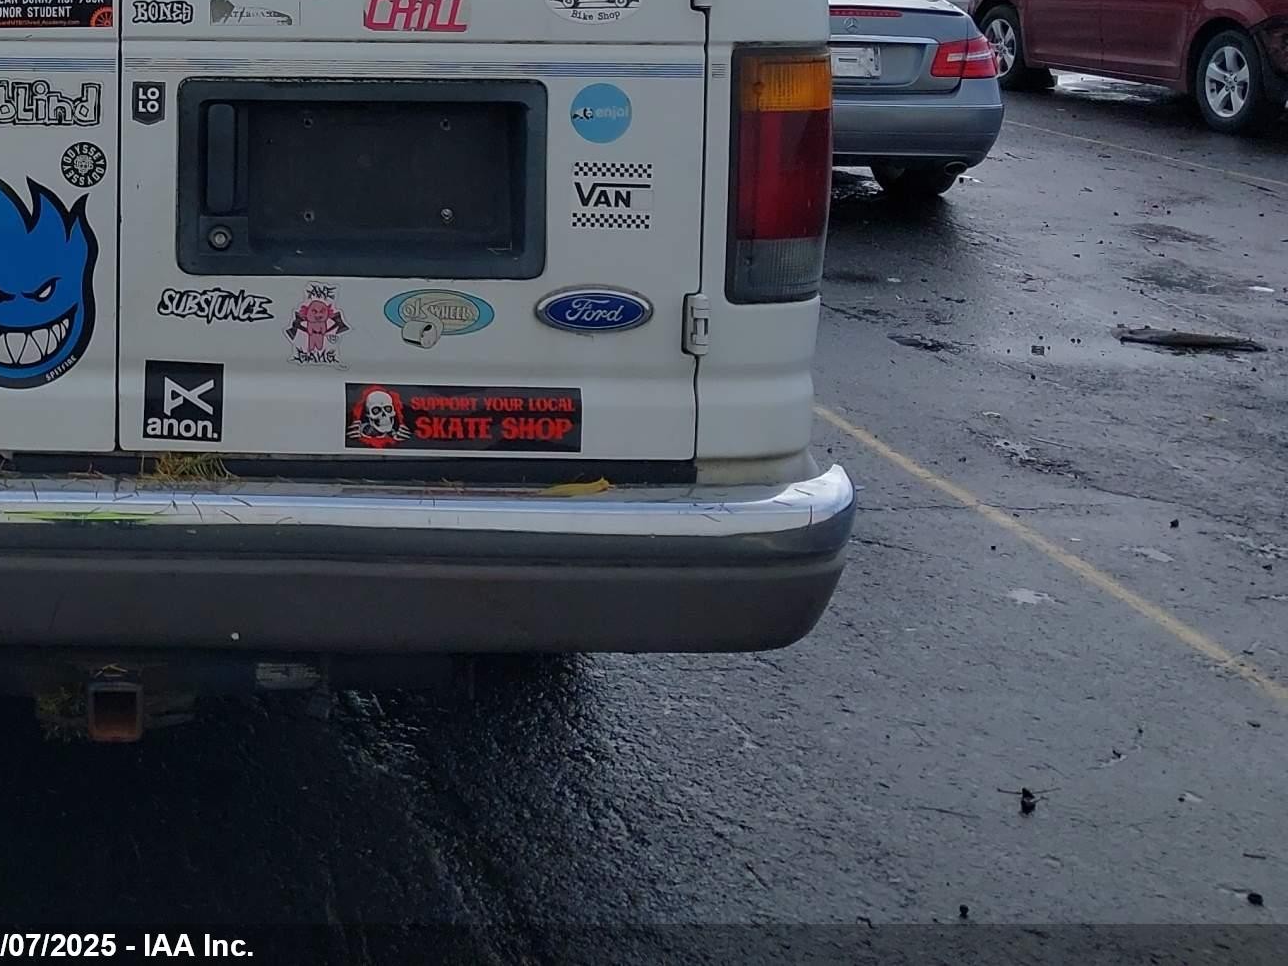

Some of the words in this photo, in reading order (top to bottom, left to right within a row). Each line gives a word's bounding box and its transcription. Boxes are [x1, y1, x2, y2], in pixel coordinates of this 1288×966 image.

[27, 6, 72, 18] STUDENT
[134, 1, 193, 22] BONES
[571, 10, 593, 20] Bike
[597, 10, 621, 20] Shop
[138, 87, 160, 100] LO
[138, 100, 160, 113] LO
[63, 144, 105, 165] ODYSSEY
[63, 163, 105, 185] ODYSSEY
[306, 286, 337, 300] AXE
[158, 288, 273, 323] SUBSTUNCE
[565, 298, 624, 323] Ford
[411, 396, 477, 412] SUPPORT
[483, 397, 524, 413] YOUR
[529, 397, 575, 413] LOCAL
[146, 417, 219, 439] anon.
[414, 416, 492, 440] SKATE
[501, 418, 573, 441] SHOP
